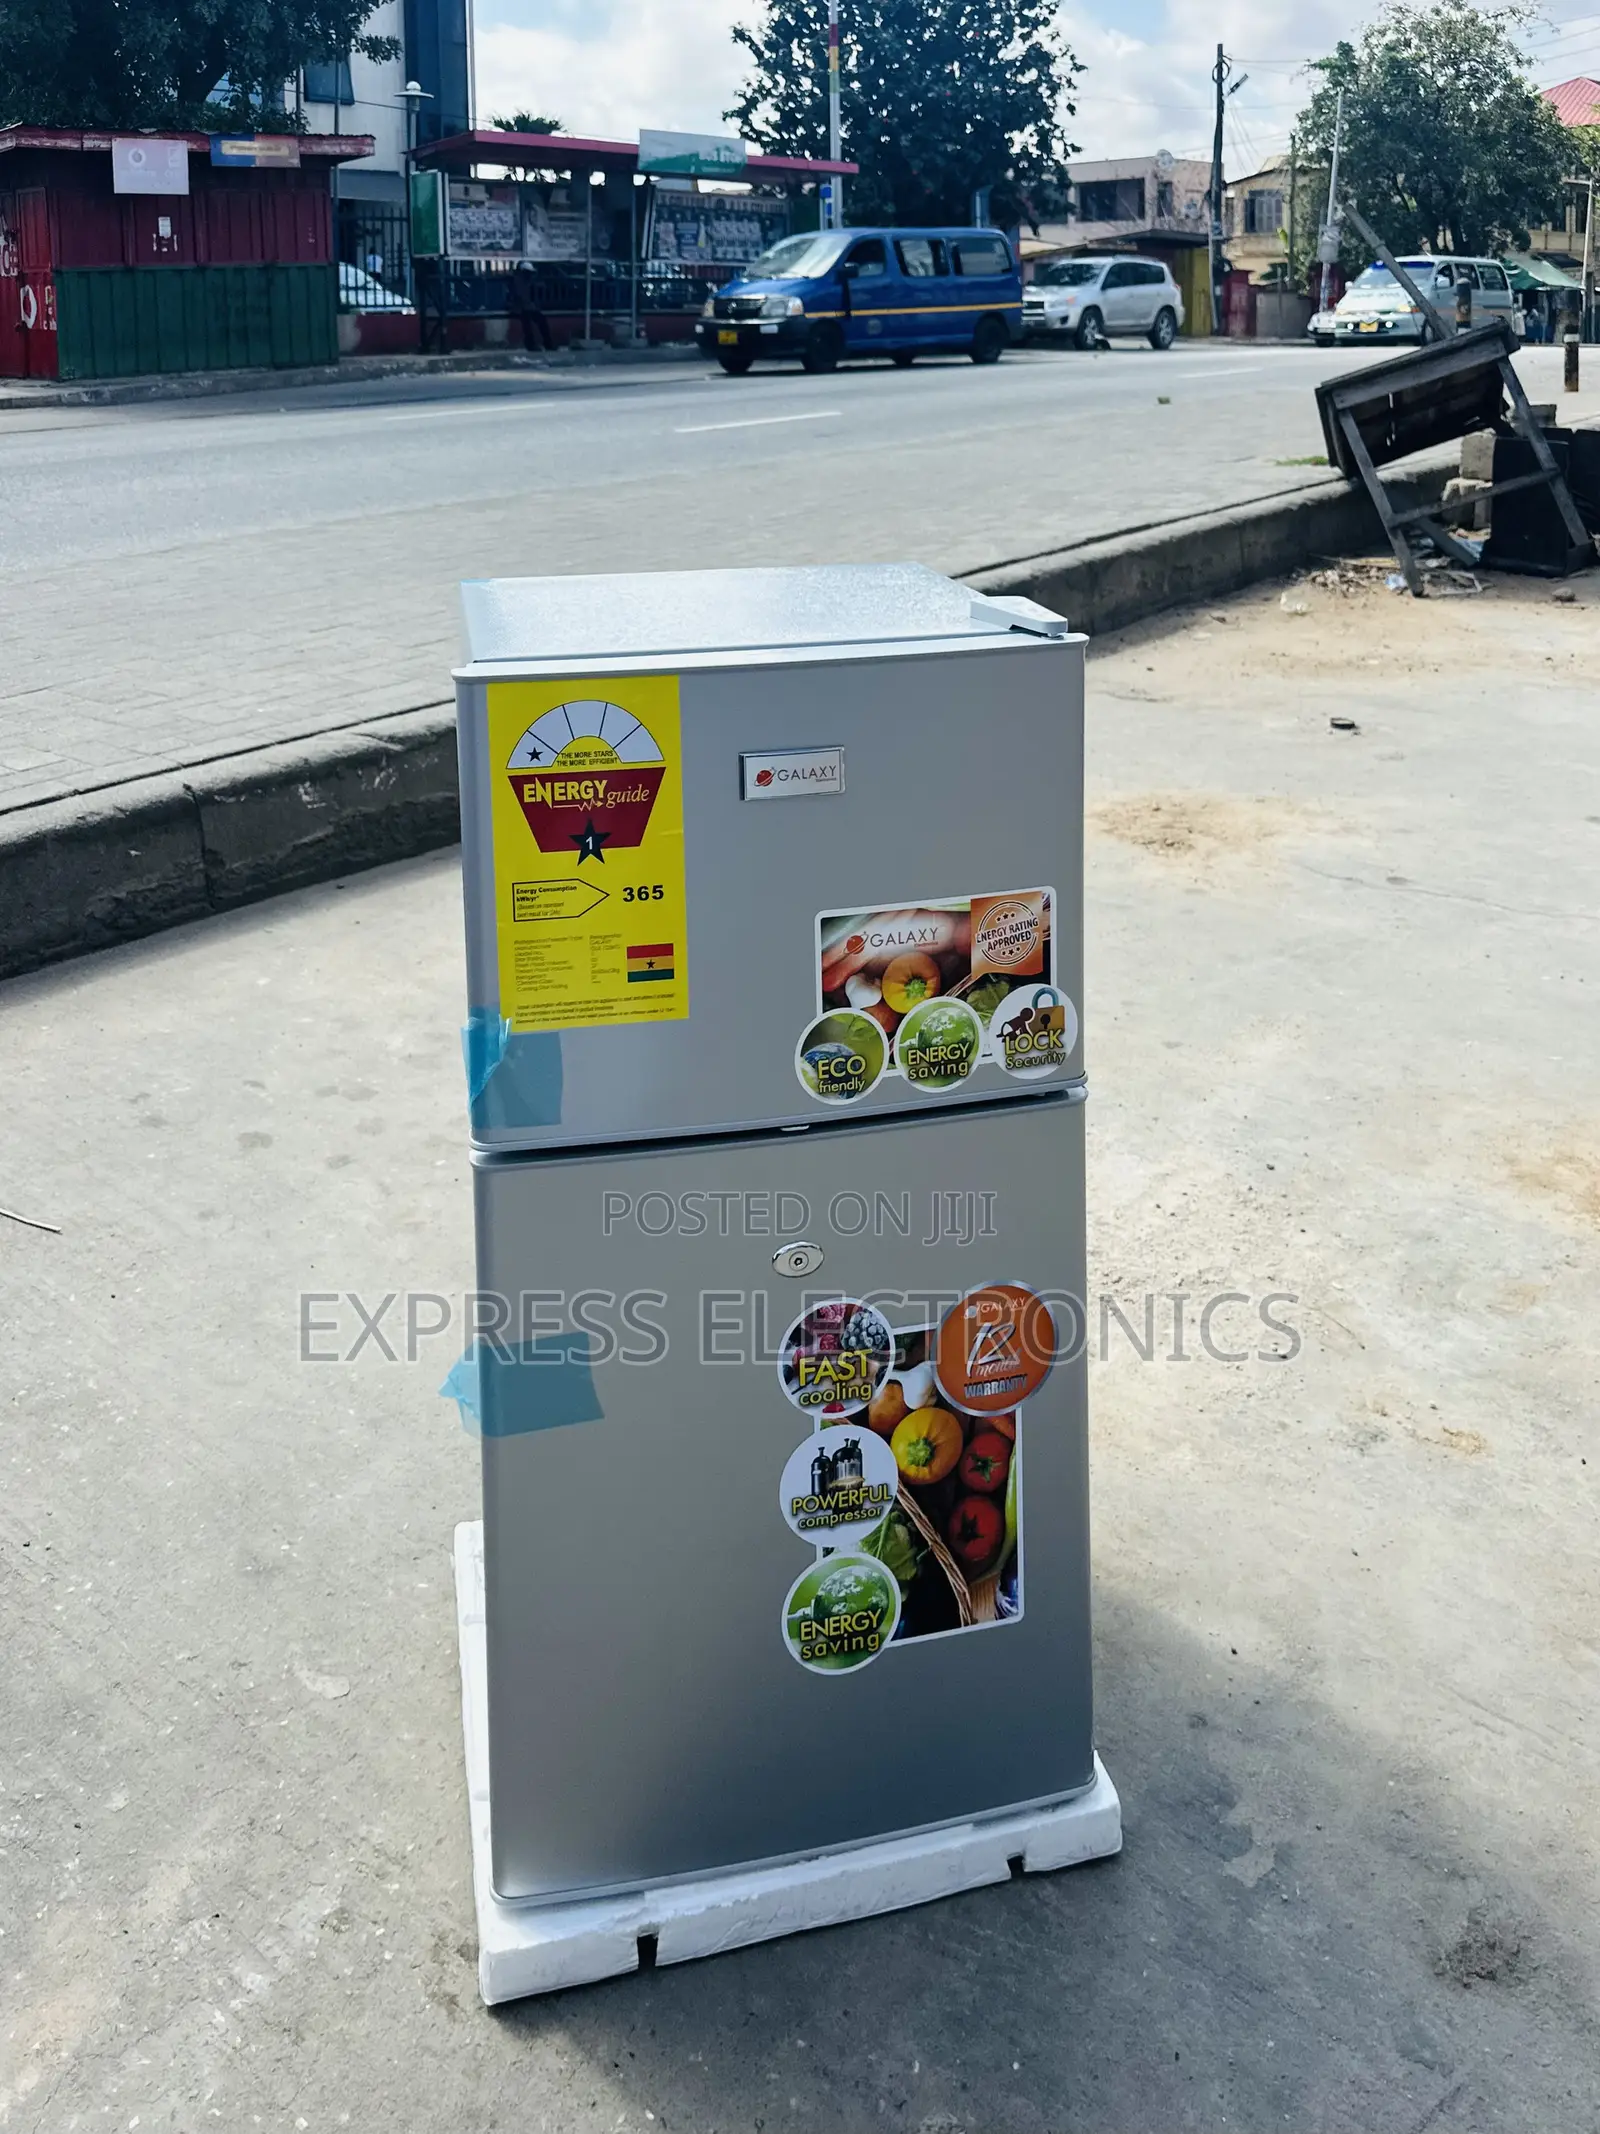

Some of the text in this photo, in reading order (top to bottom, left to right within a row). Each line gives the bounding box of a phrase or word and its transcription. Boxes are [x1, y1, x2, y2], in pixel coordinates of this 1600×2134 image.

[588, 757, 618, 766] EFFICIENT
[593, 750, 614, 758] STARS
[777, 765, 837, 781] GALAXY
[523, 777, 650, 809] ENERGY guide
[585, 836, 593, 850] 1
[516, 885, 577, 896] Energy Consumption
[622, 885, 664, 902] 365
[870, 927, 939, 948] GALAXY
[976, 916, 1039, 944] ENERGY RATING
[987, 929, 1032, 952] APPROVED
[1005, 1028, 1064, 1055] LOCK
[907, 1042, 970, 1066] ENERGY
[1005, 1050, 1067, 1070] Security
[817, 1055, 867, 1079] ECO
[907, 1060, 969, 1080] saving
[818, 1077, 866, 1094] friendly
[981, 1297, 1026, 1314] GALAXY
[965, 1322, 1017, 1378] 12
[799, 1348, 873, 1388] FAST
[800, 1381, 872, 1406] cooling
[964, 1373, 1028, 1399] WARRANTY
[792, 1483, 892, 1515] POWERFUL
[798, 1505, 883, 1530] compressor
[800, 1608, 883, 1642] ENERGY
[801, 1631, 880, 1660] saving
